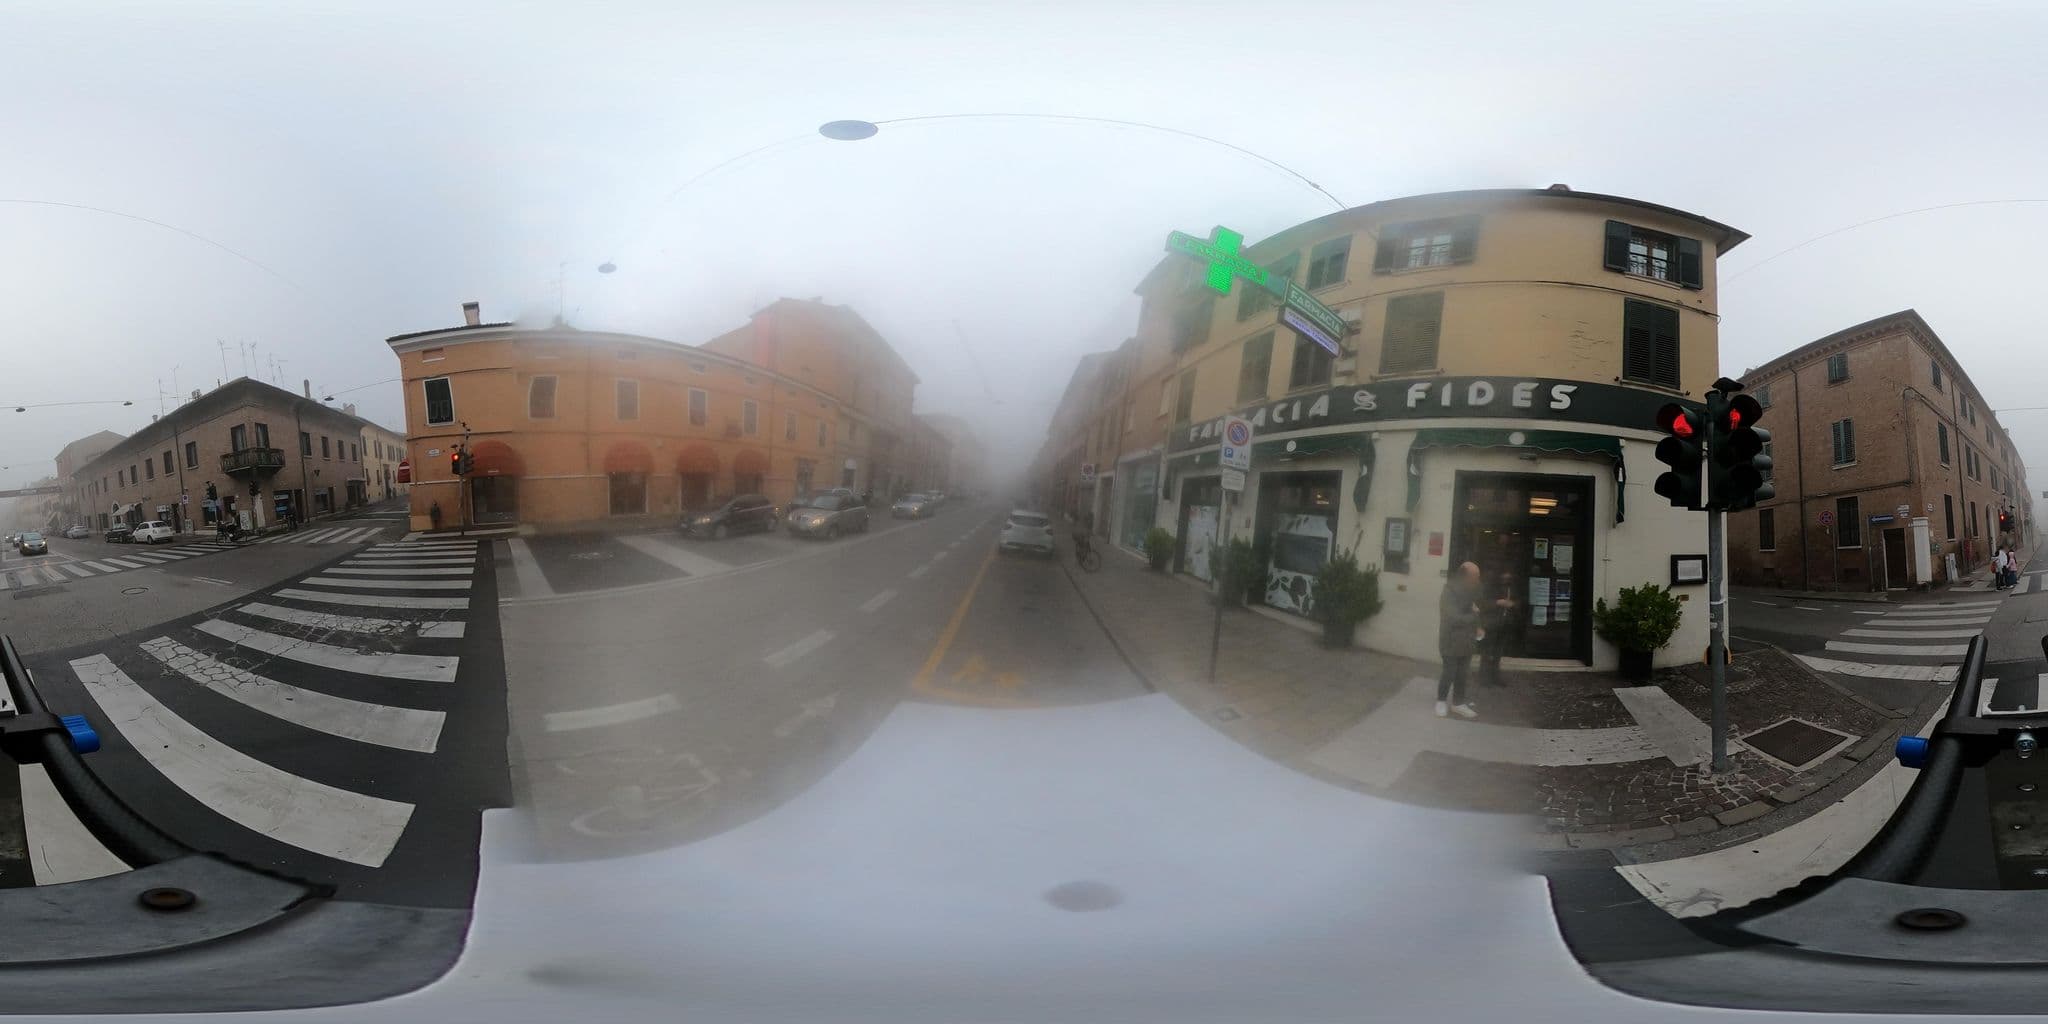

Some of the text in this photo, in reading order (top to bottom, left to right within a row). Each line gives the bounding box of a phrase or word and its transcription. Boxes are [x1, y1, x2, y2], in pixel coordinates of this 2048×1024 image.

[1291, 289, 1341, 334] FARMACIA
[1190, 395, 1330, 442] FARACIA
[1407, 380, 1578, 410] FIDES
